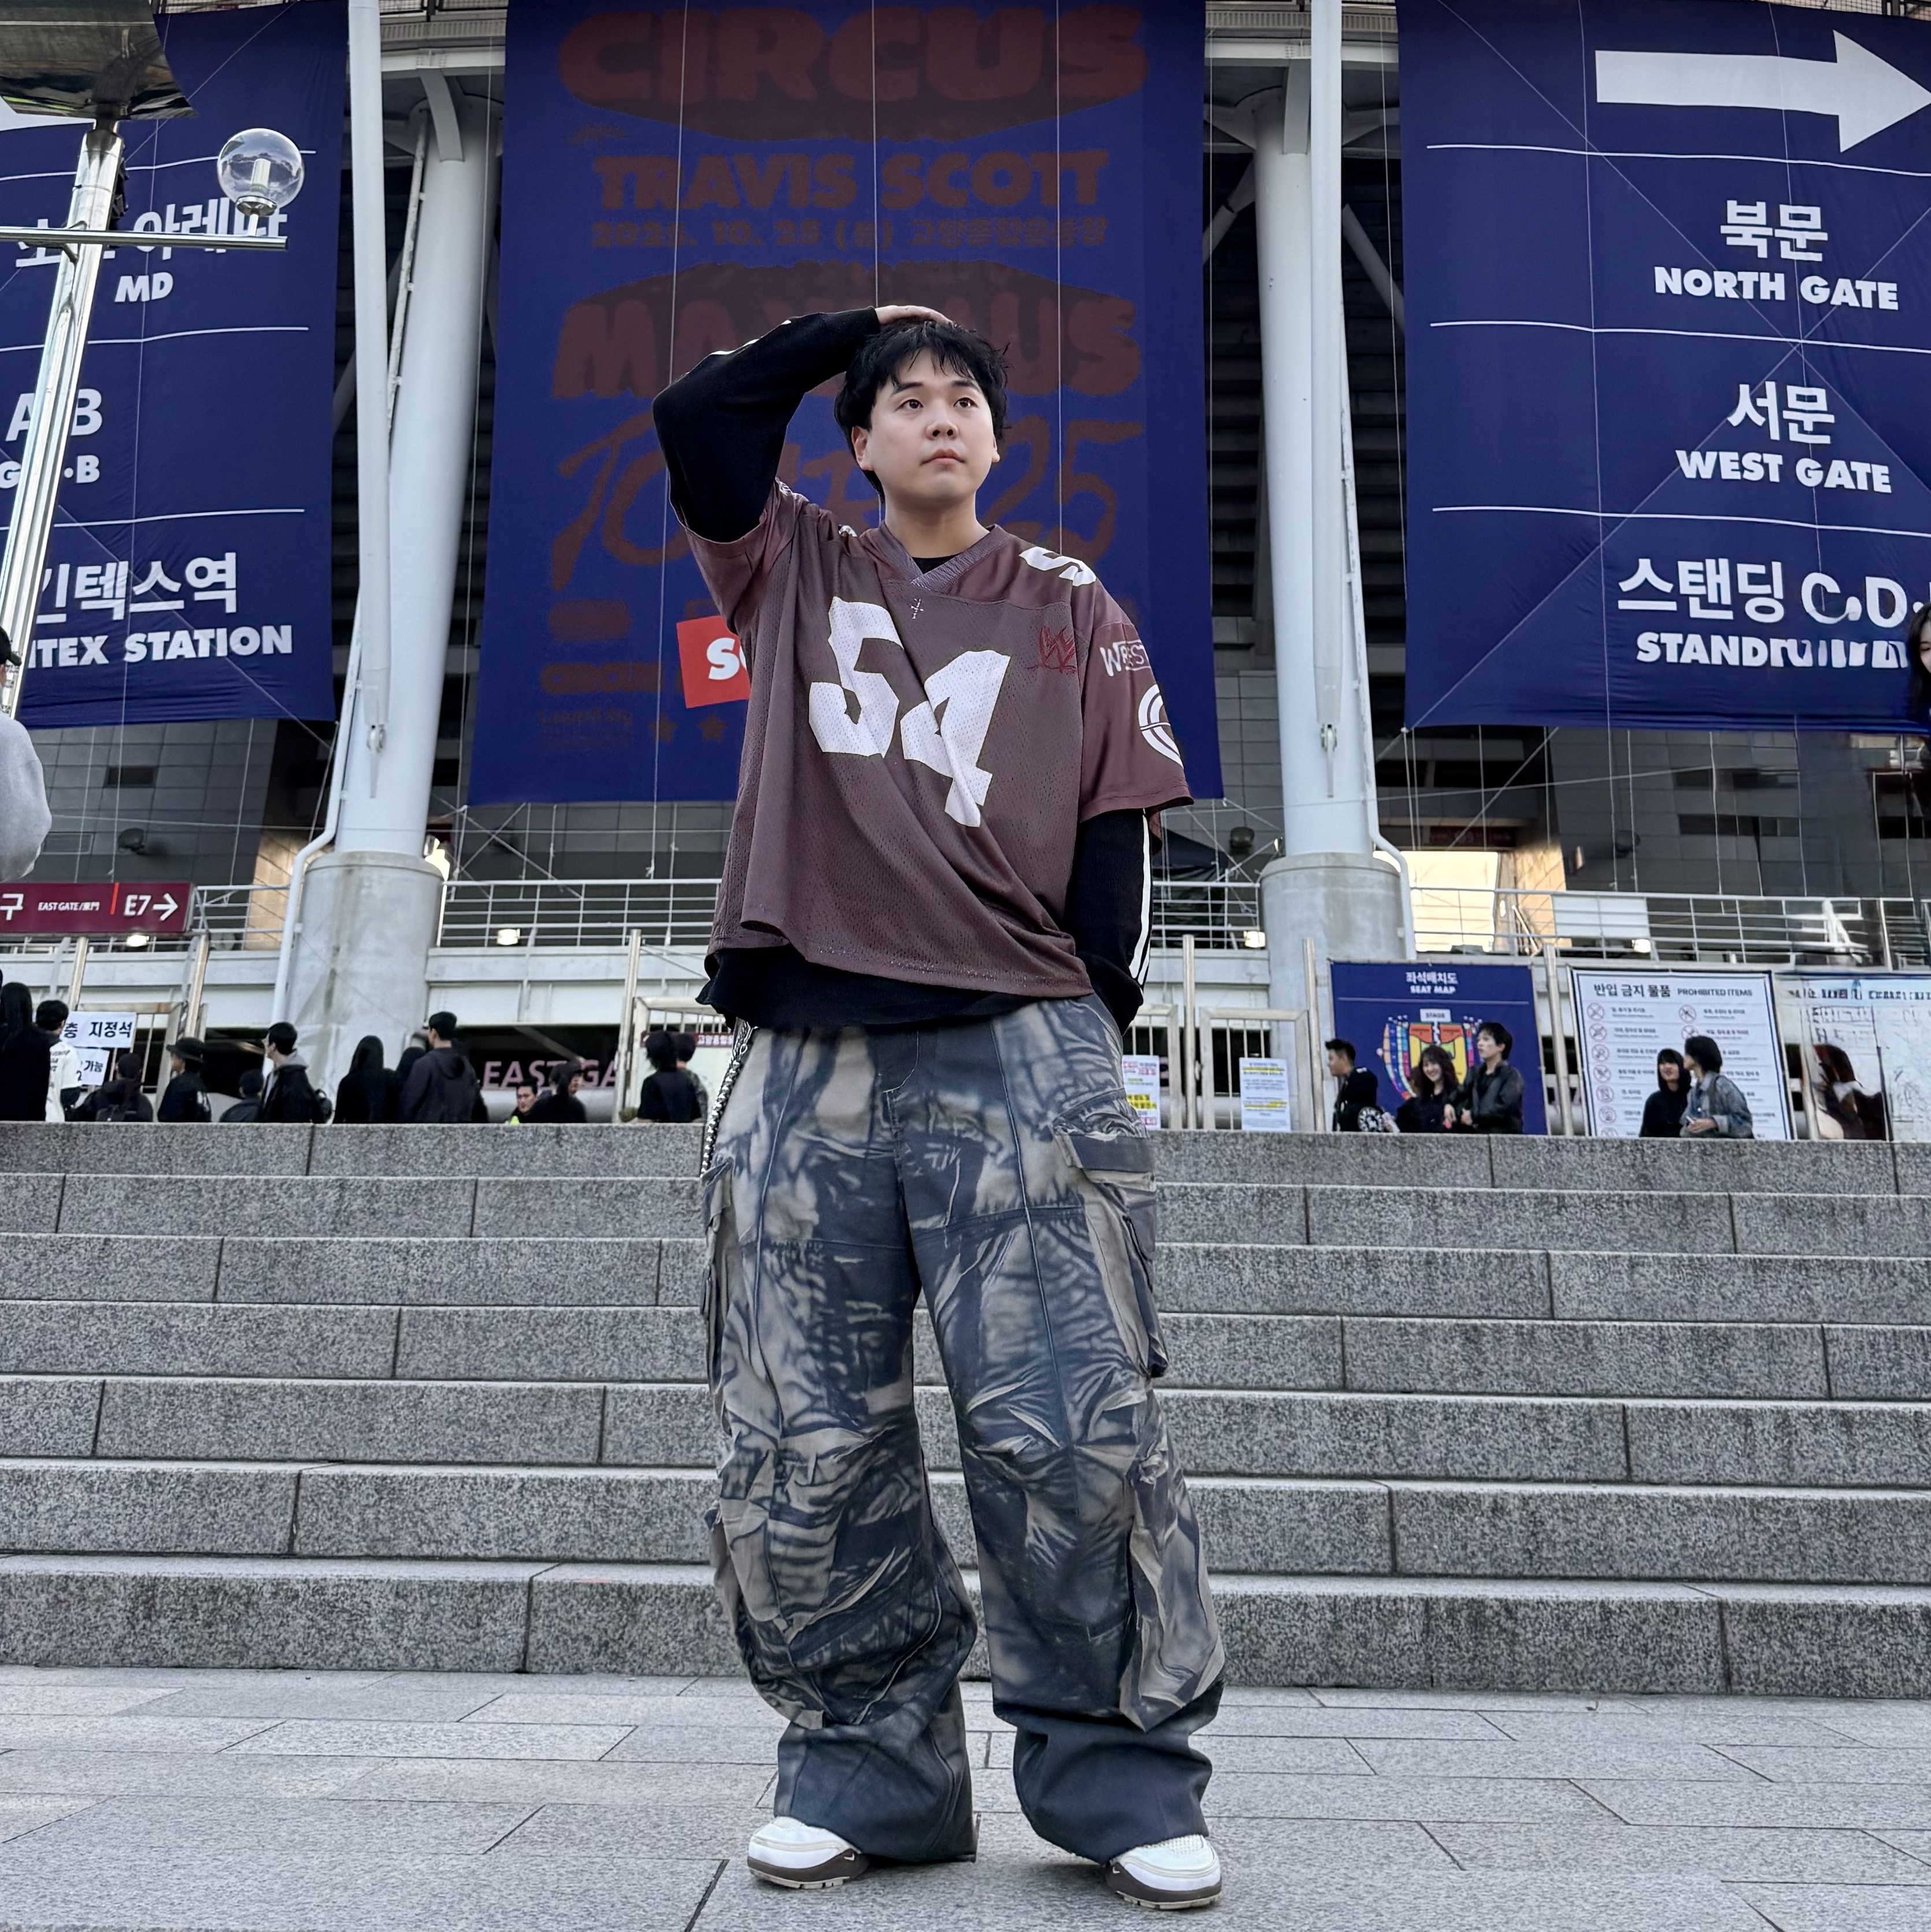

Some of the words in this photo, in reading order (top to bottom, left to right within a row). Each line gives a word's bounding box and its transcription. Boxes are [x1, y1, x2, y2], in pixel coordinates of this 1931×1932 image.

[558, 5, 1149, 104] CIRCUS
[592, 154, 858, 210] TRAVIS
[880, 150, 1109, 209] SCOTT
[773, 219, 821, 246] 25
[1721, 201, 1828, 261] 북문
[115, 272, 173, 302] MD
[1655, 267, 1785, 300] NORTH
[1800, 276, 1898, 310] GATE
[1728, 382, 1834, 443] 서문
[1676, 450, 1782, 482] WEST
[1796, 458, 1891, 493] GATE
[1618, 558, 1784, 623] 스탠딩
[124, 626, 292, 662] STATION
[809, 596, 1011, 827] 54
[38, 902, 58, 911] EAST
[124, 895, 151, 916] E7
[1406, 971, 1458, 984] 좌석배치도
[1410, 985, 1432, 994] SEAT
[1433, 986, 1456, 994] MAP
[1593, 984, 1618, 997] 반입
[1621, 984, 1644, 997] 금지
[1648, 984, 1670, 998] 물품
[1677, 987, 1726, 996] PROHIBITED
[1727, 988, 1752, 997] ITEMS
[88, 1021, 132, 1038] 지정석
